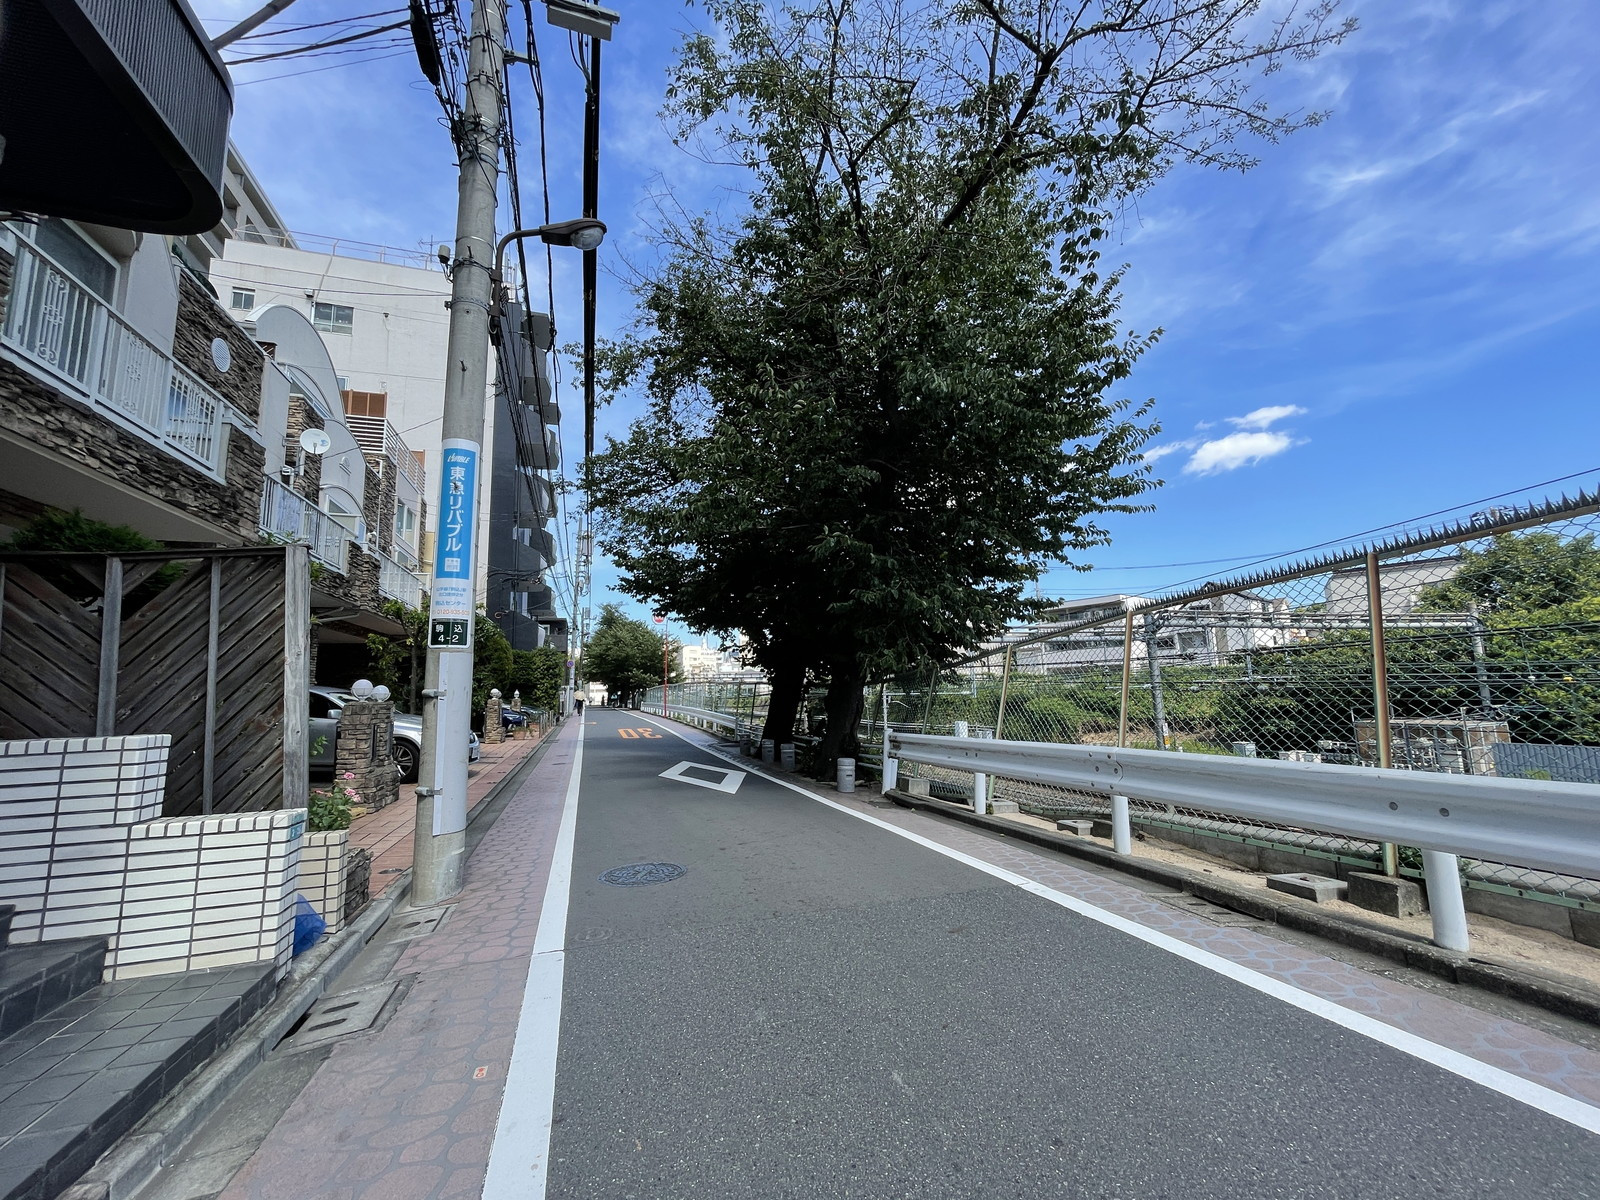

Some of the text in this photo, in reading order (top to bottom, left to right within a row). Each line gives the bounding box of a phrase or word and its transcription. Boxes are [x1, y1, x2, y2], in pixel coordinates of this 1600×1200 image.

[444, 466, 466, 552] 東急リバブル
[435, 624, 463, 633] 駒込
[438, 634, 459, 643] 4-2
[617, 727, 663, 739] 30
